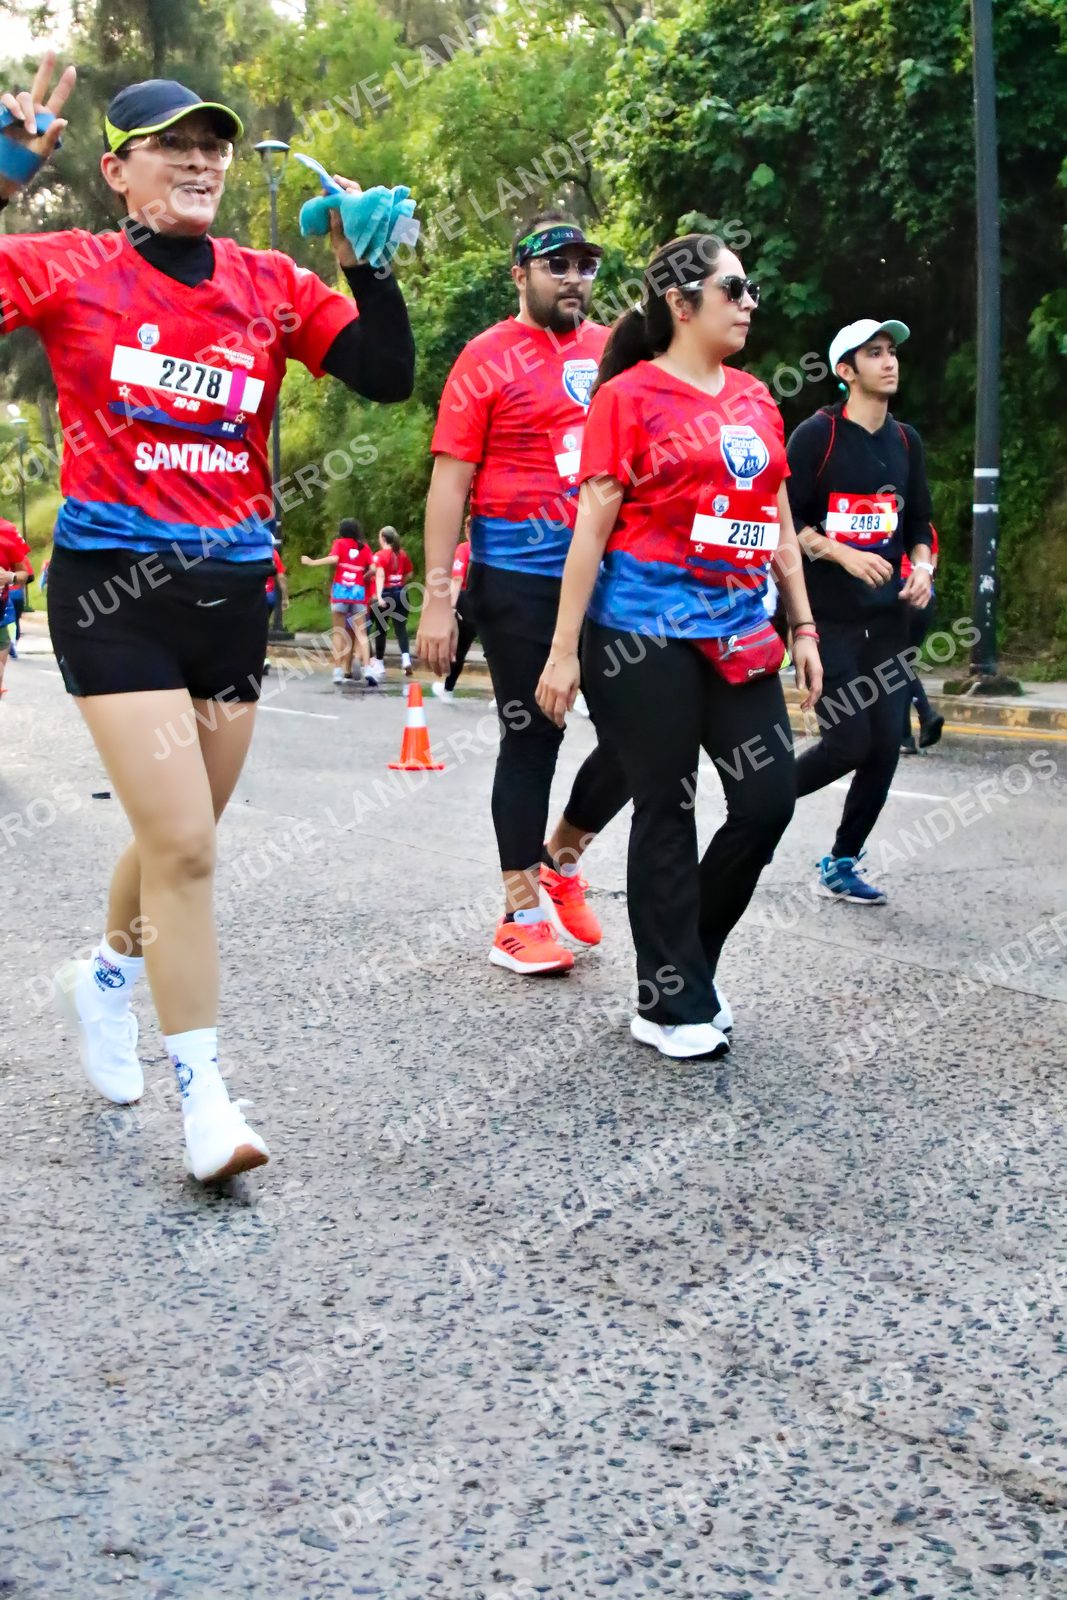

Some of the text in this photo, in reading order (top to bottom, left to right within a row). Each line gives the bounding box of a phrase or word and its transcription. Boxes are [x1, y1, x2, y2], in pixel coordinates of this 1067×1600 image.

[159, 358, 223, 400] 2278
[221, 421, 237, 433] 5K
[850, 515, 881, 531] 2483
[727, 522, 765, 547] 2331
